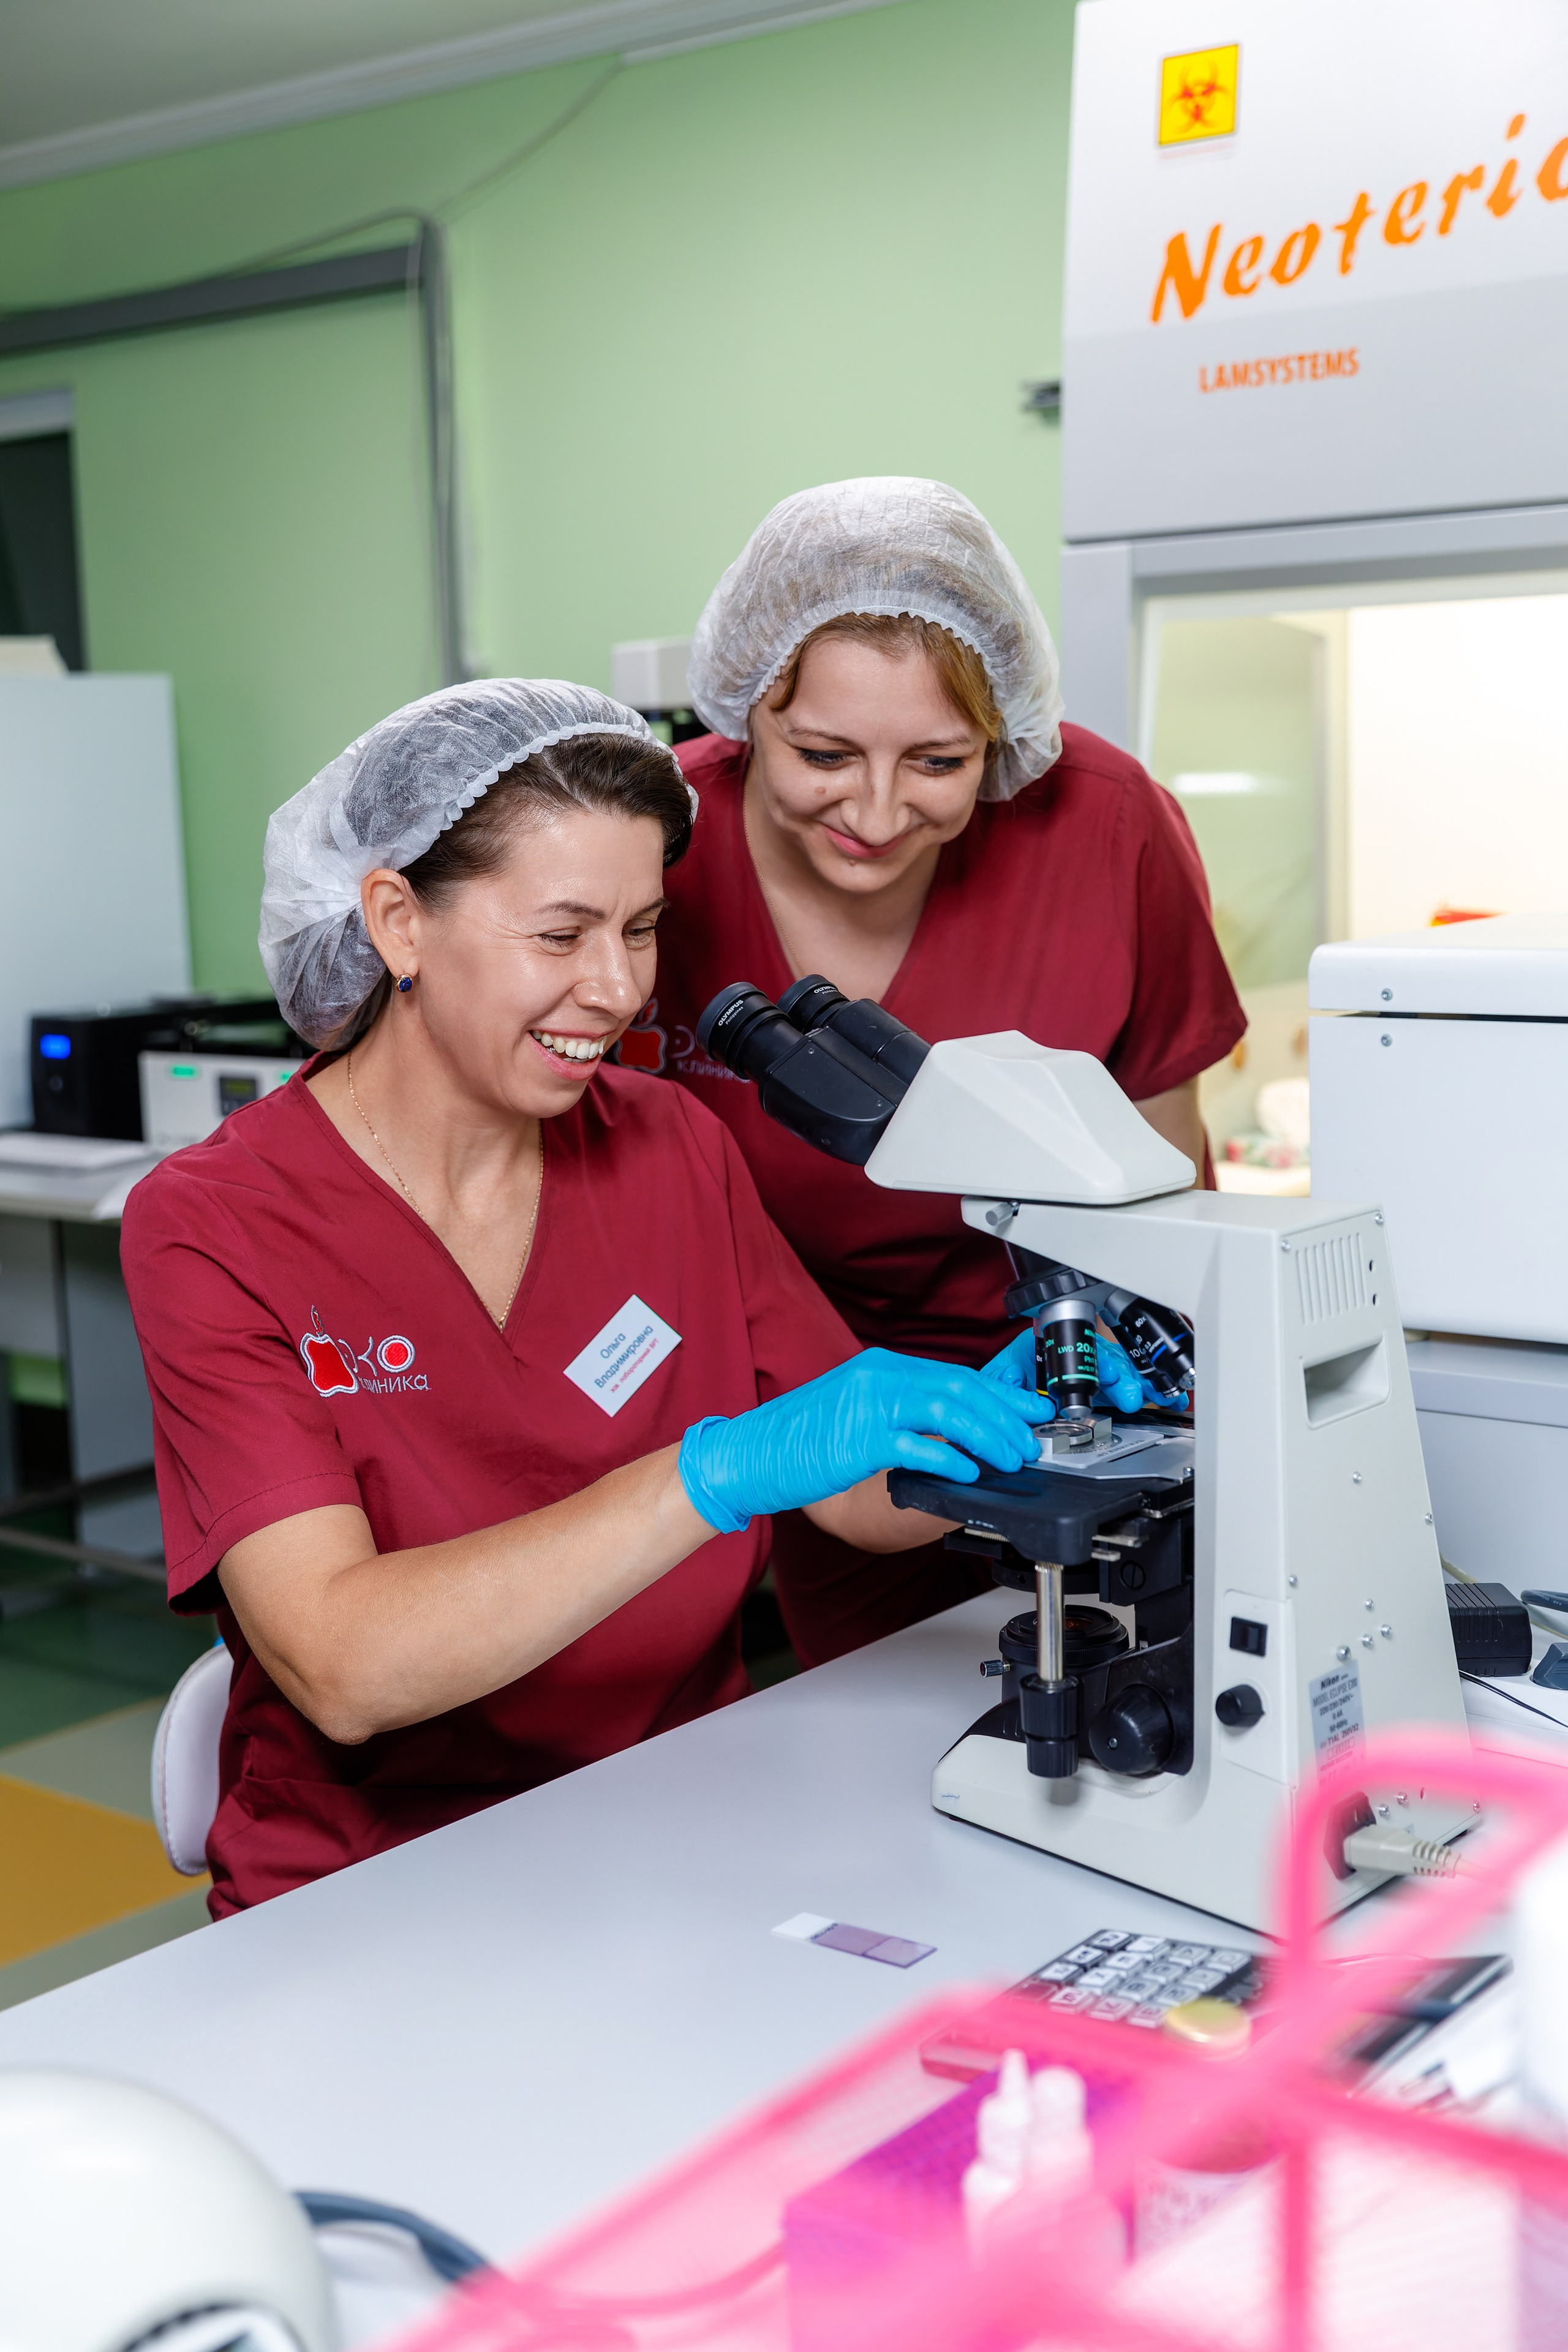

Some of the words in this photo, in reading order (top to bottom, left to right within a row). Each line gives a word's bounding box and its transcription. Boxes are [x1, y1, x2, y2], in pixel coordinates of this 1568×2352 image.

[1199, 347, 1359, 394] LAMSYSTEMS
[718, 1000, 744, 1027] OLYMPUS
[725, 1006, 744, 1025] Philippines
[594, 1325, 654, 1389] Владимировна
[599, 1333, 626, 1359] Ольга
[1057, 1345, 1074, 1354] LWD
[1321, 1675, 1340, 1691] Nikon
